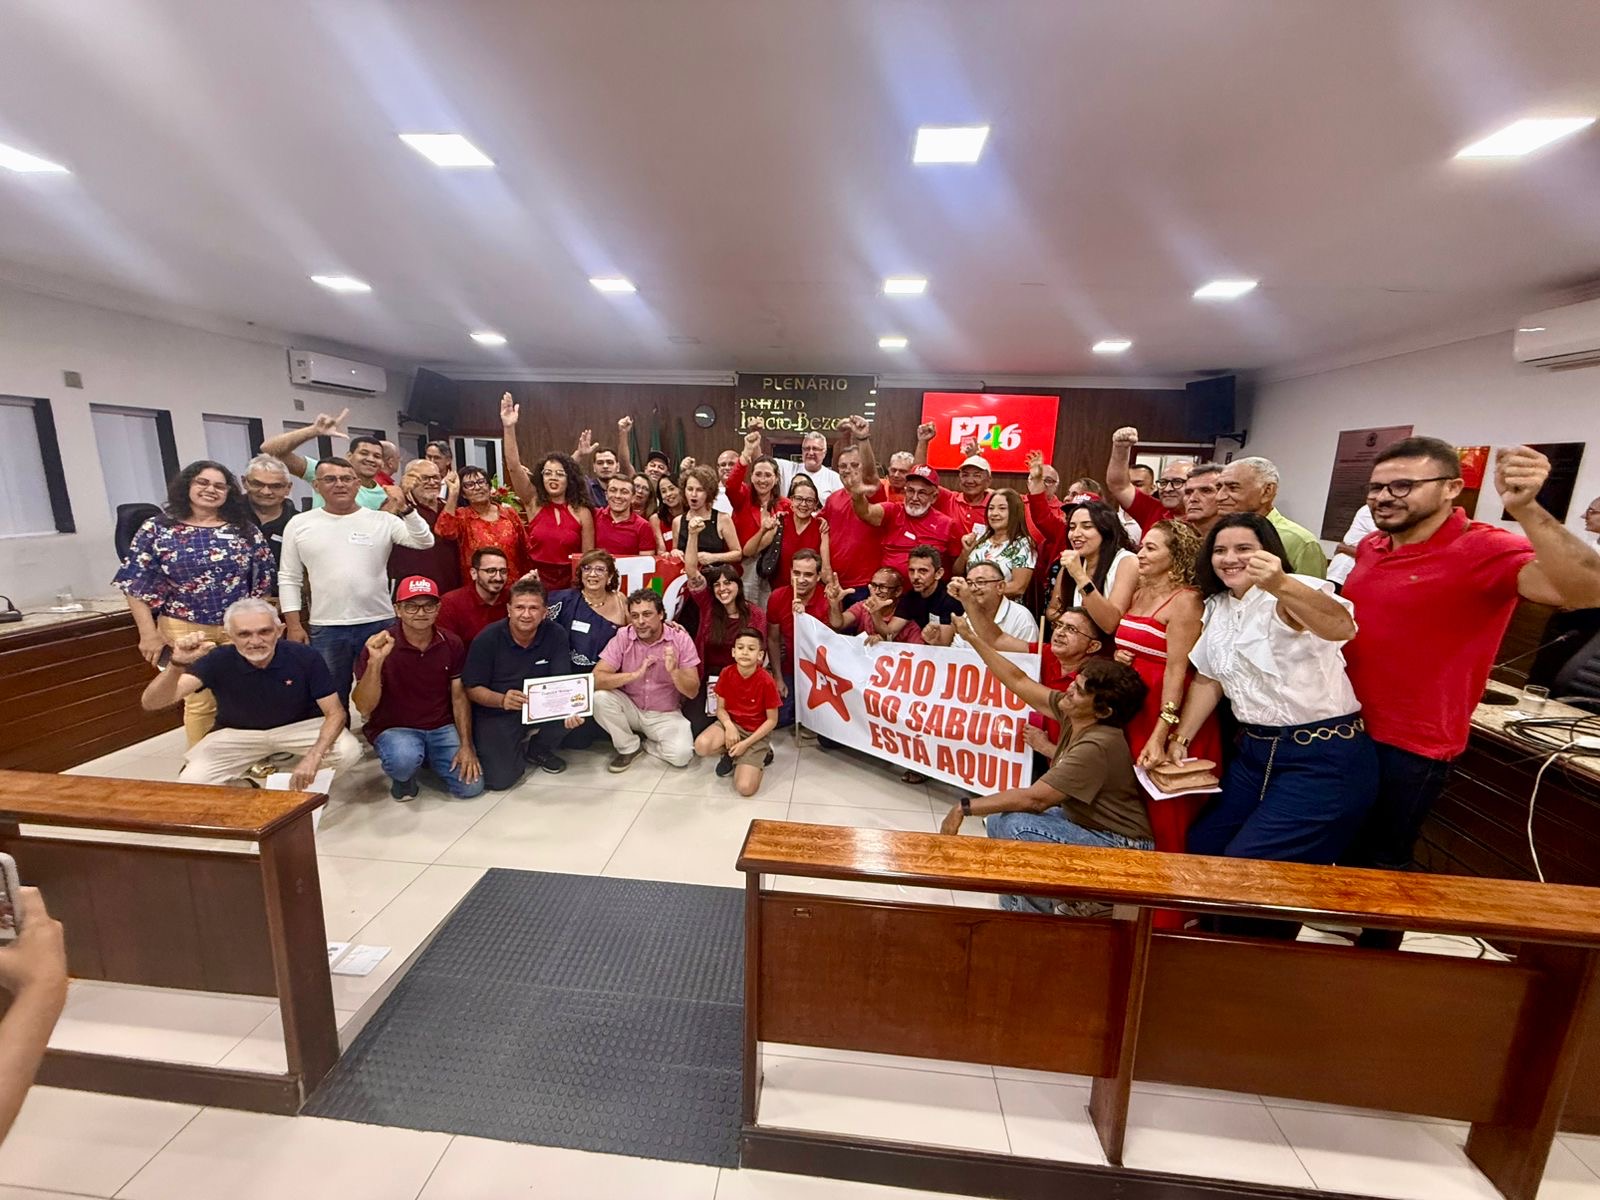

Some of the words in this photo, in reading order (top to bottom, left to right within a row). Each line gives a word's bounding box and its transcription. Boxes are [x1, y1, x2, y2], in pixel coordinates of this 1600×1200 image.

[762, 375, 848, 391] PLENÁRIO
[740, 398, 805, 411] PREFEITO
[815, 669, 838, 697] PT
[869, 650, 936, 698] SÃO
[863, 688, 901, 725] DO
[904, 700, 1026, 754] SABUGI
[868, 720, 932, 768] ESTÁ
